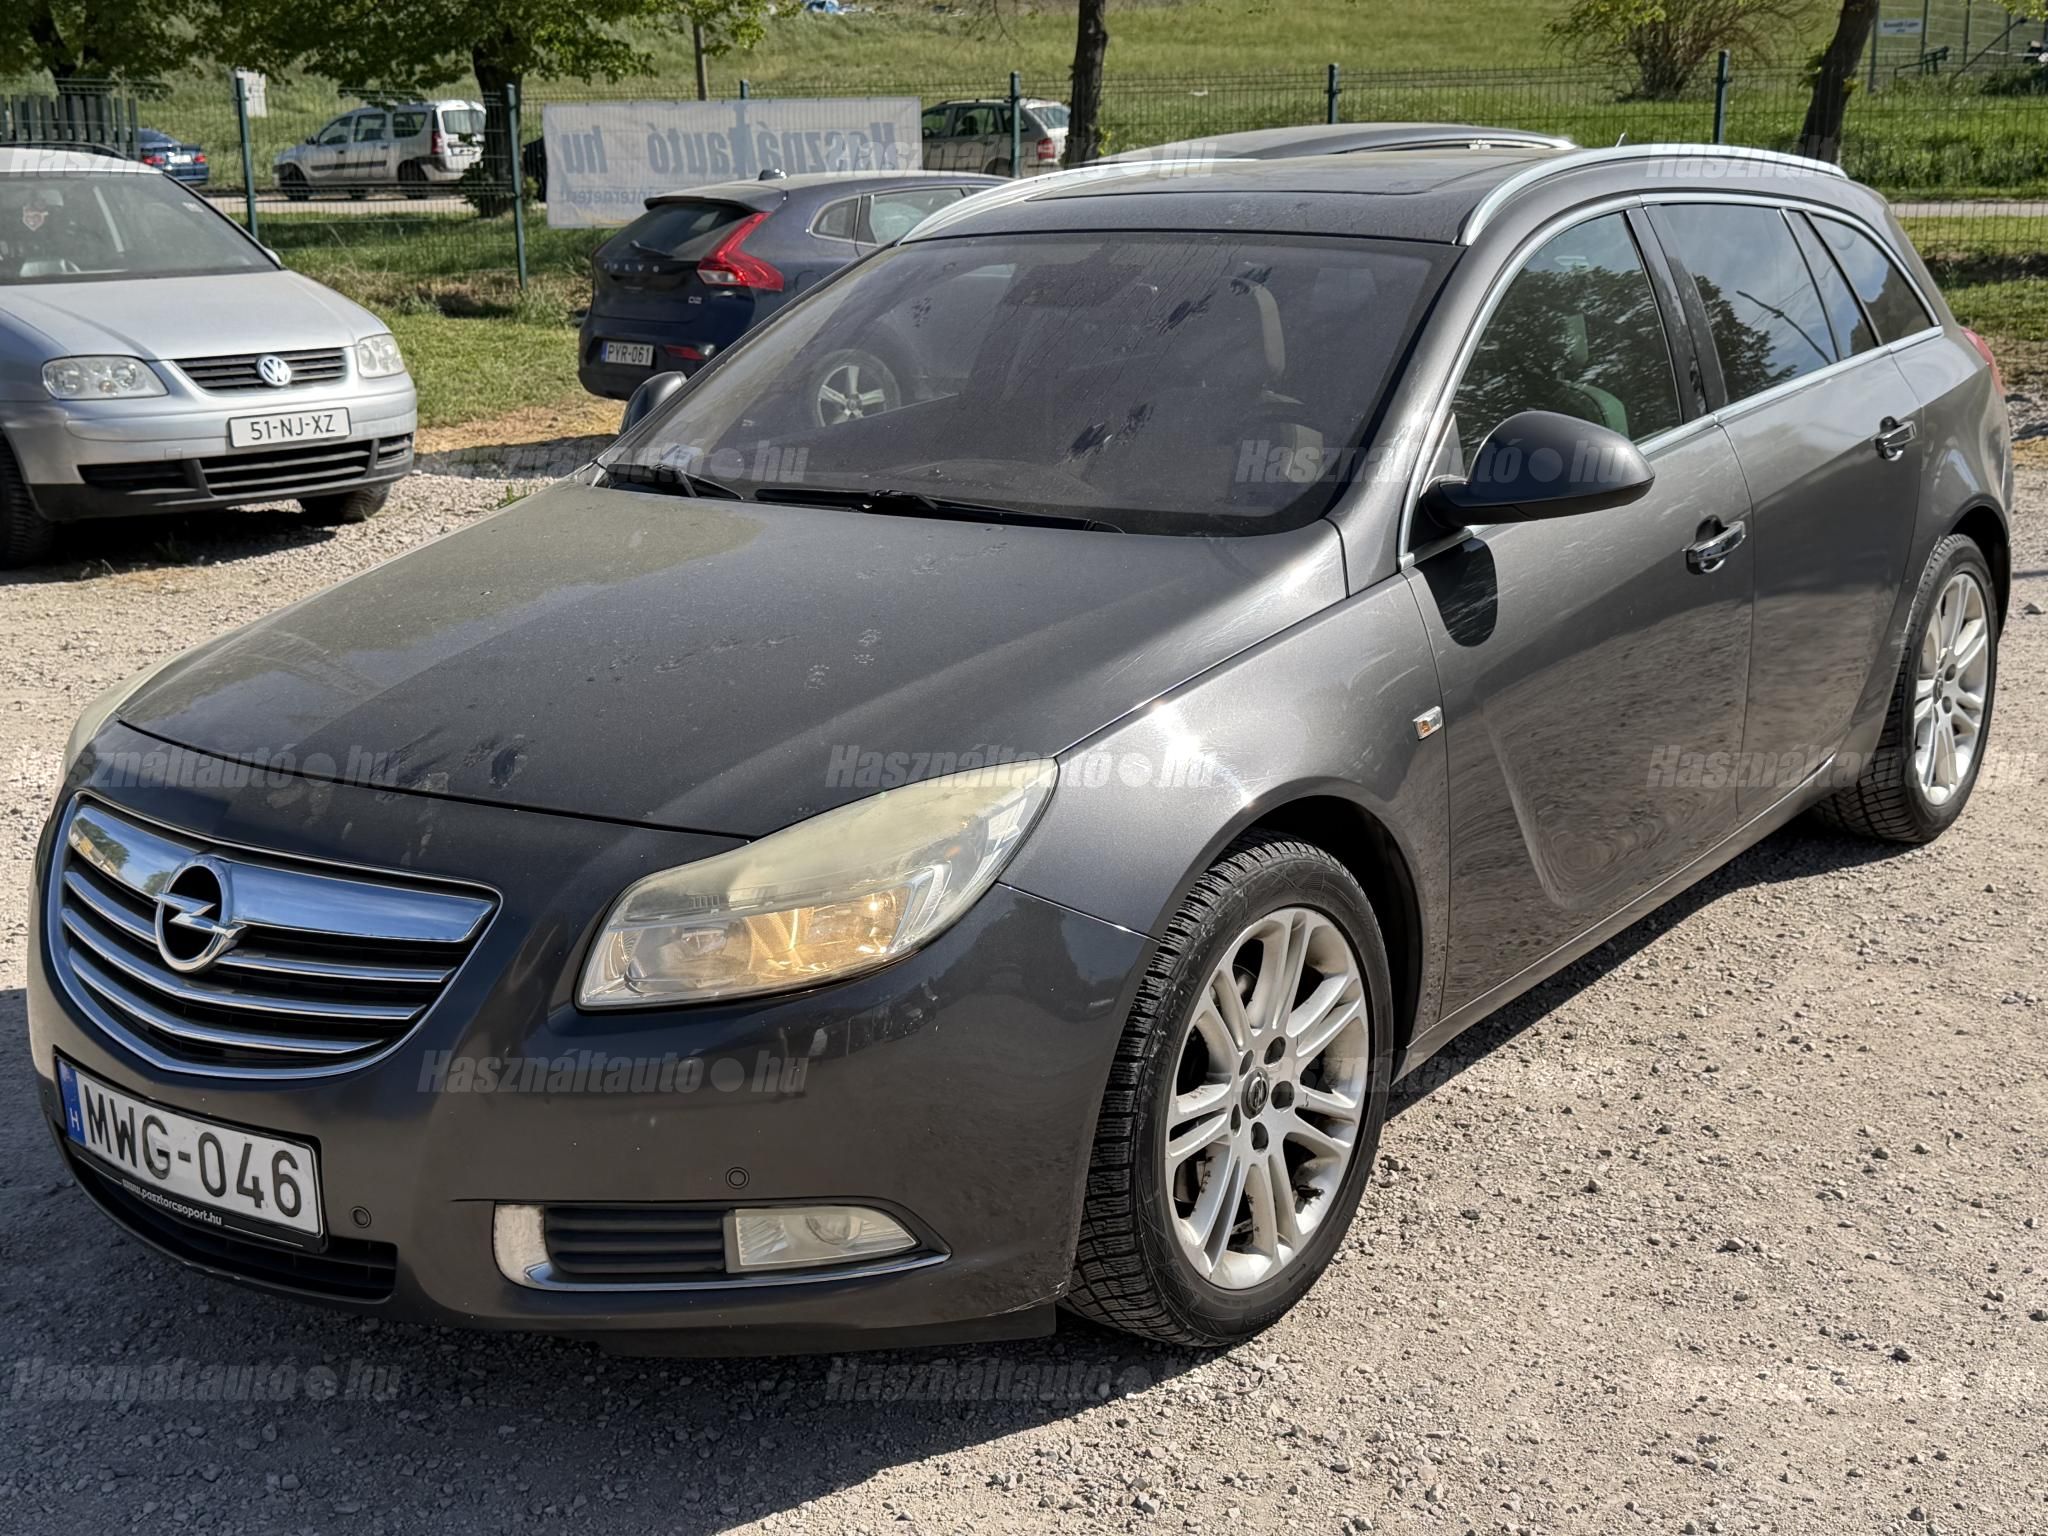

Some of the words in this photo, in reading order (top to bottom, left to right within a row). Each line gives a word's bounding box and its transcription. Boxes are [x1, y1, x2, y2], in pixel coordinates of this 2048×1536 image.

[607, 343, 652, 364] PYR-061
[251, 415, 335, 440] 51-NJ-XZ
[84, 1084, 301, 1218] MWG-046
[123, 1178, 223, 1226] www.pasztorcsoport.hu
